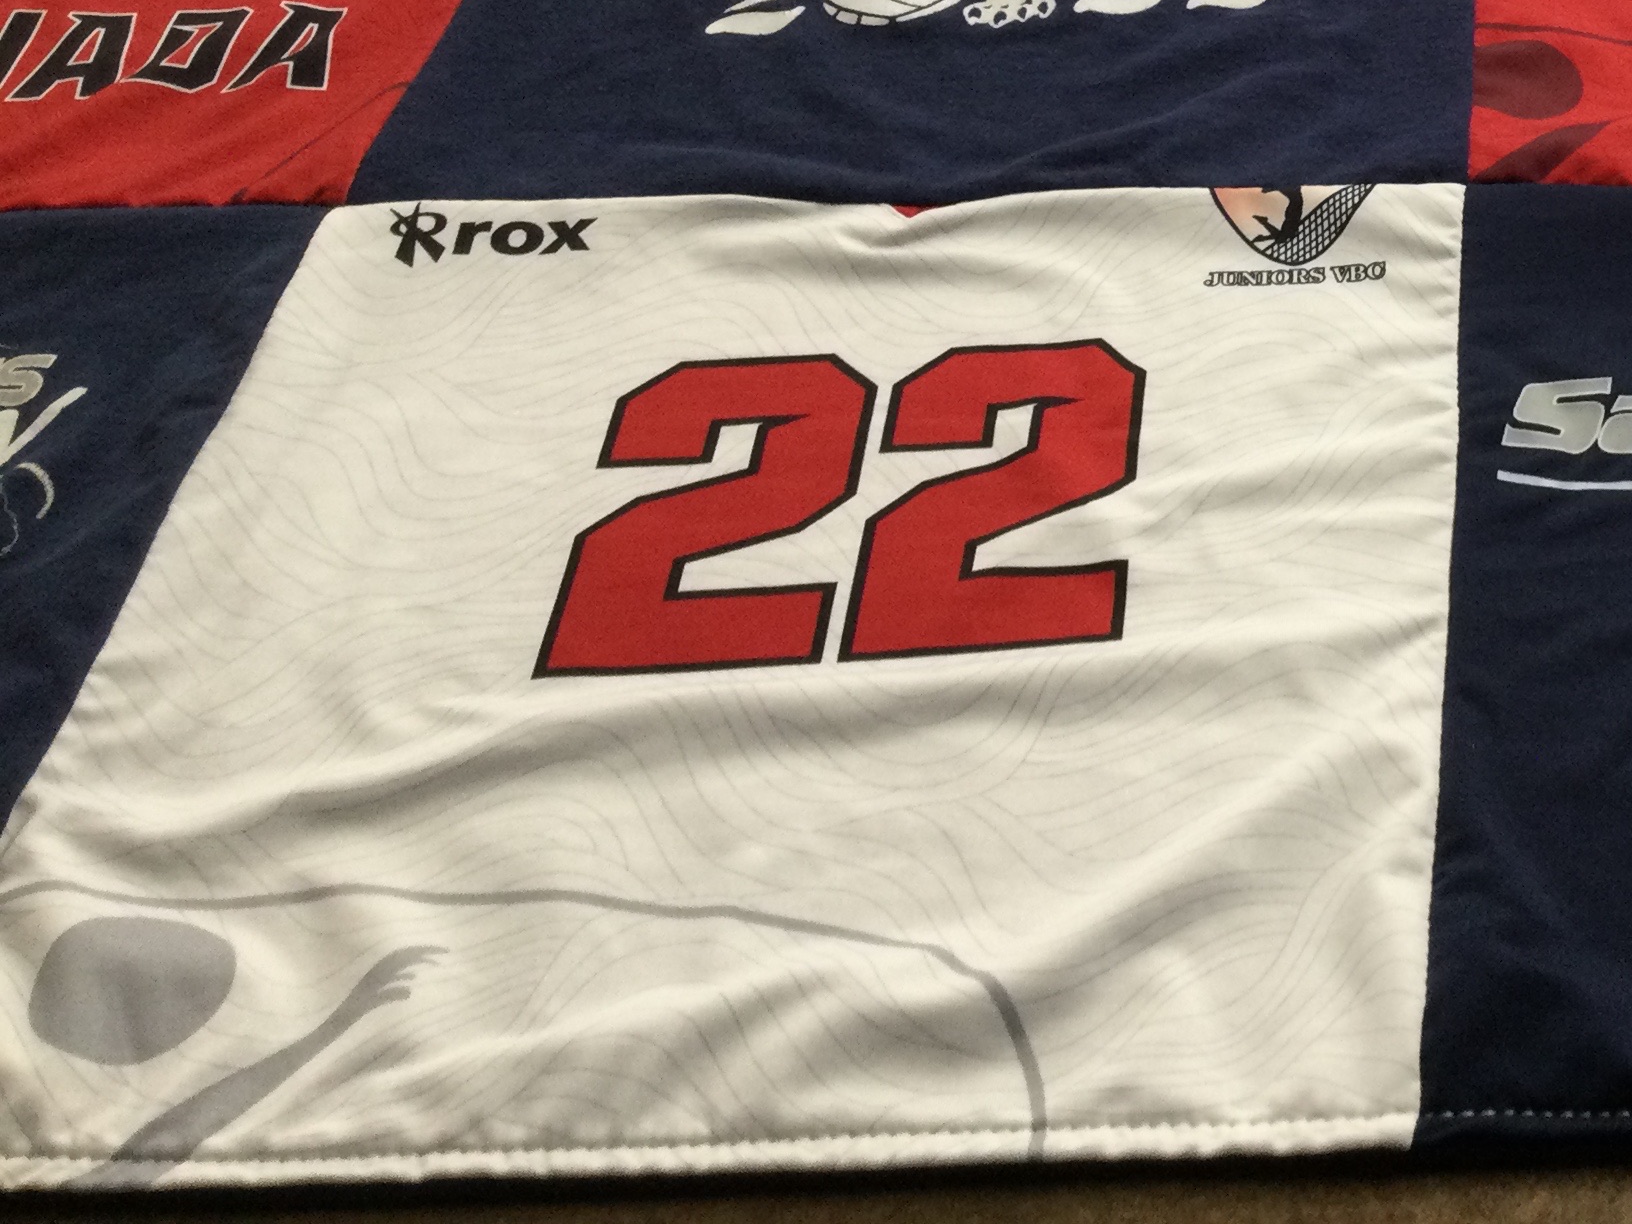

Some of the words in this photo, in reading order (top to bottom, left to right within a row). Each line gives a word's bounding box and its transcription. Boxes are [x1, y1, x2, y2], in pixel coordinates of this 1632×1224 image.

[1203, 267, 1327, 288] JUNIORS
[1328, 261, 1387, 284] VBC
[530, 337, 1148, 681] 22
